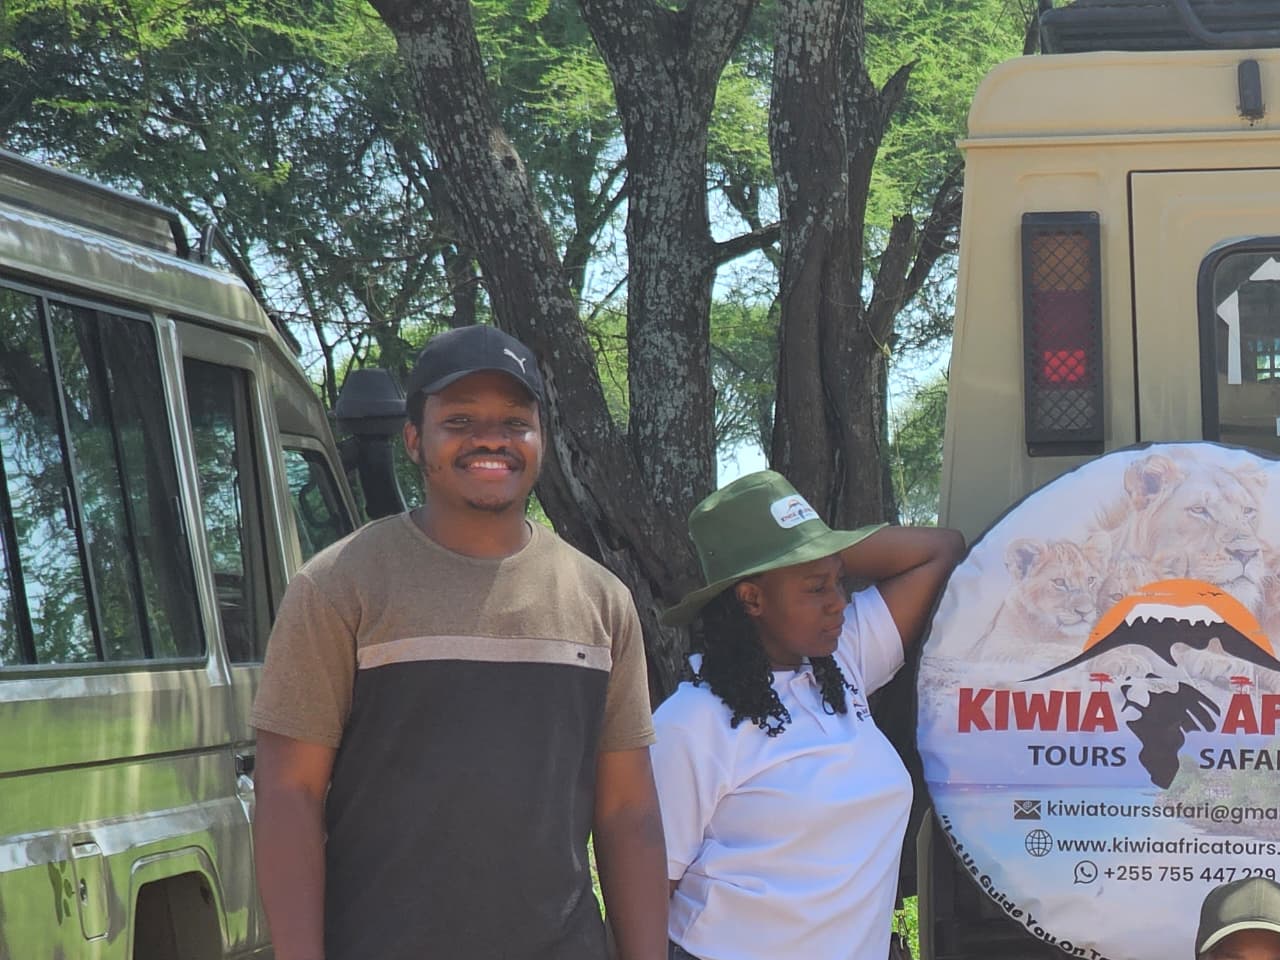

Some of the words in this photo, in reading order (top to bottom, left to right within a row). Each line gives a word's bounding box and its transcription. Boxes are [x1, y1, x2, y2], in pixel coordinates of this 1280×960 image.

[958, 687, 1118, 733] KIWIA
[1028, 745, 1126, 767] TOURS
[1103, 865, 1153, 882] +255
[1158, 866, 1194, 882] 755
[1199, 867, 1237, 883] 447
[980, 874, 1023, 918] Guide
[1026, 912, 1057, 945] You
[1059, 940, 1086, 957] On
